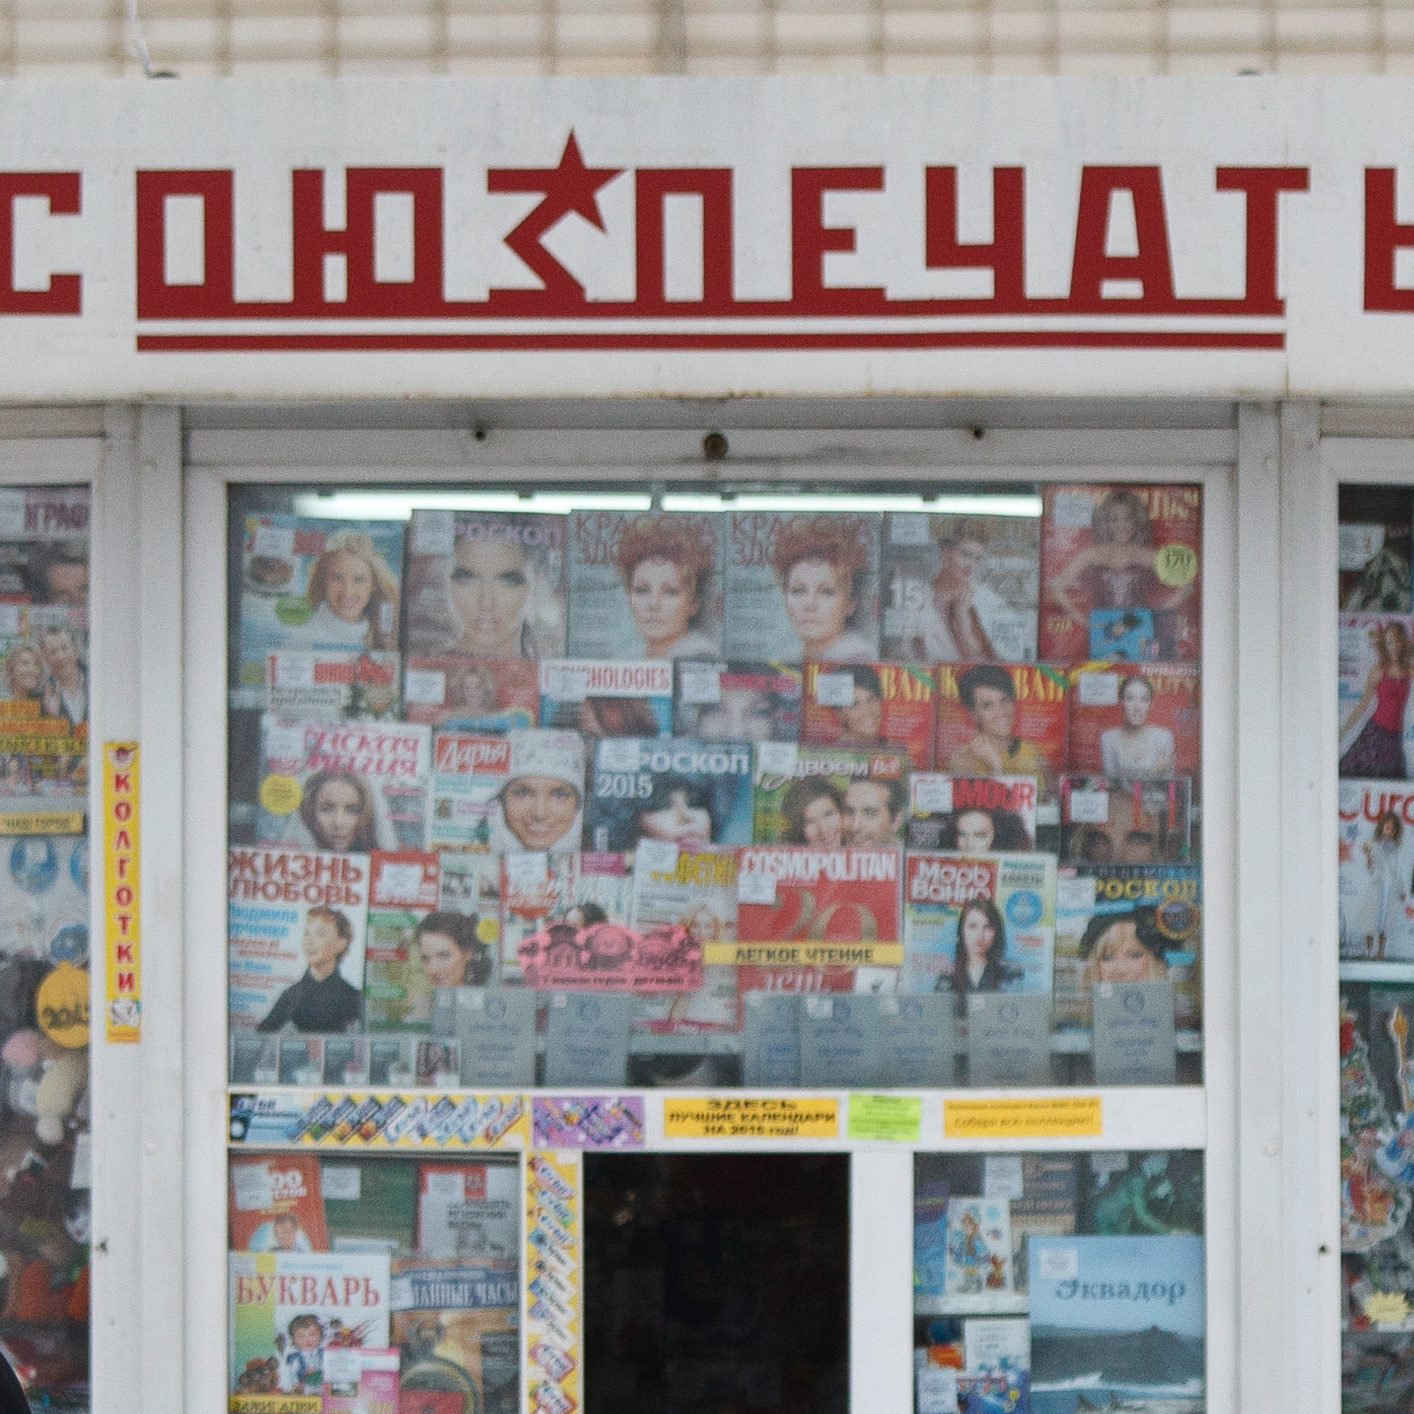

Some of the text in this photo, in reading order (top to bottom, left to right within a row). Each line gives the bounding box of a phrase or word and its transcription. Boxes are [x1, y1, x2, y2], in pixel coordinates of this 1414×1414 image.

[113, 772, 135, 992] КОЛГОТКИ
[736, 948, 874, 962] ЛЕГКОЕ ЧТЕНИЕ
[707, 1098, 798, 1112] ЗДЕСЬ
[235, 1274, 382, 1309] БУКВАРЬ
[1054, 1279, 1187, 1306] Эквадор
